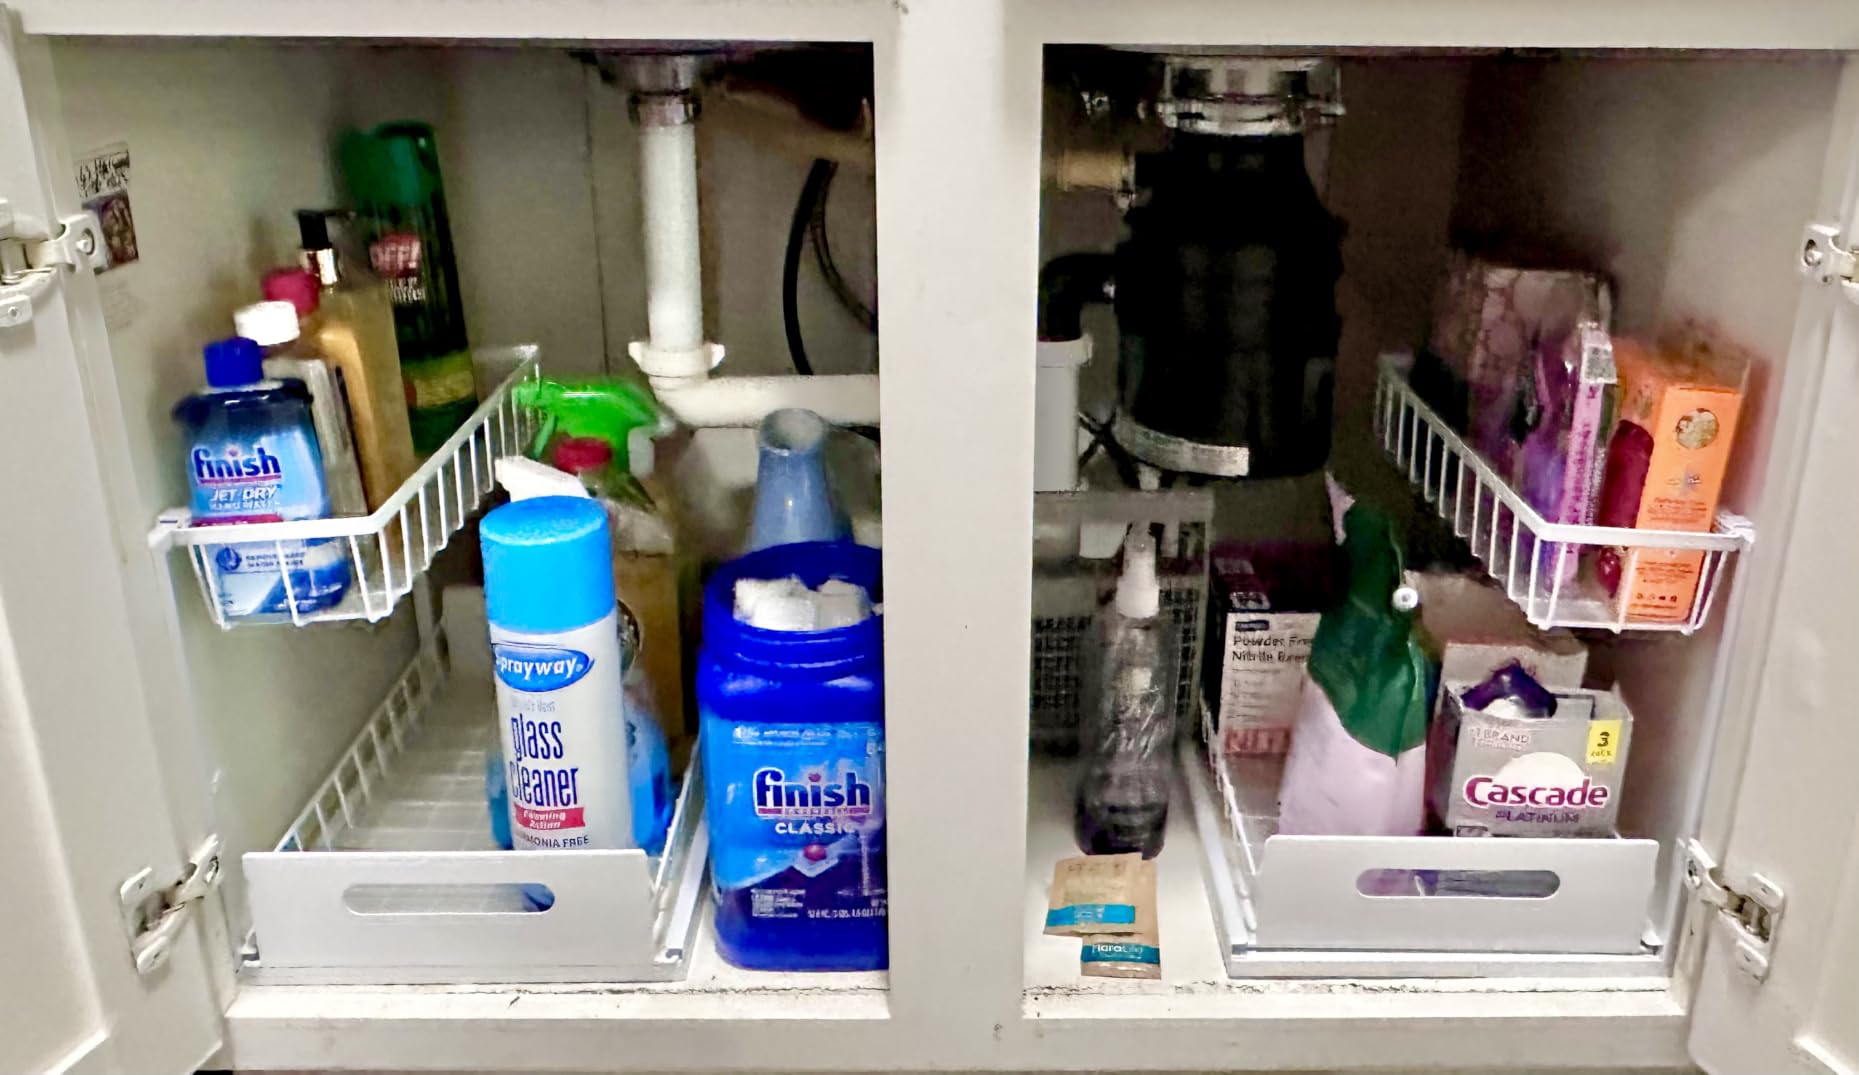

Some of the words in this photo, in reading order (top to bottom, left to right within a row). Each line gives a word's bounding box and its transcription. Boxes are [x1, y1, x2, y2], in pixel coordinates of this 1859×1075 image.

[193, 446, 281, 478] finish
[512, 713, 564, 761] glass
[1597, 731, 1611, 748] 3
[509, 761, 579, 807] cleaner
[755, 769, 870, 807] finish
[1464, 775, 1610, 808] Cascade
[775, 822, 854, 834] CLASSIC
[1495, 810, 1581, 824] PLATINUM
